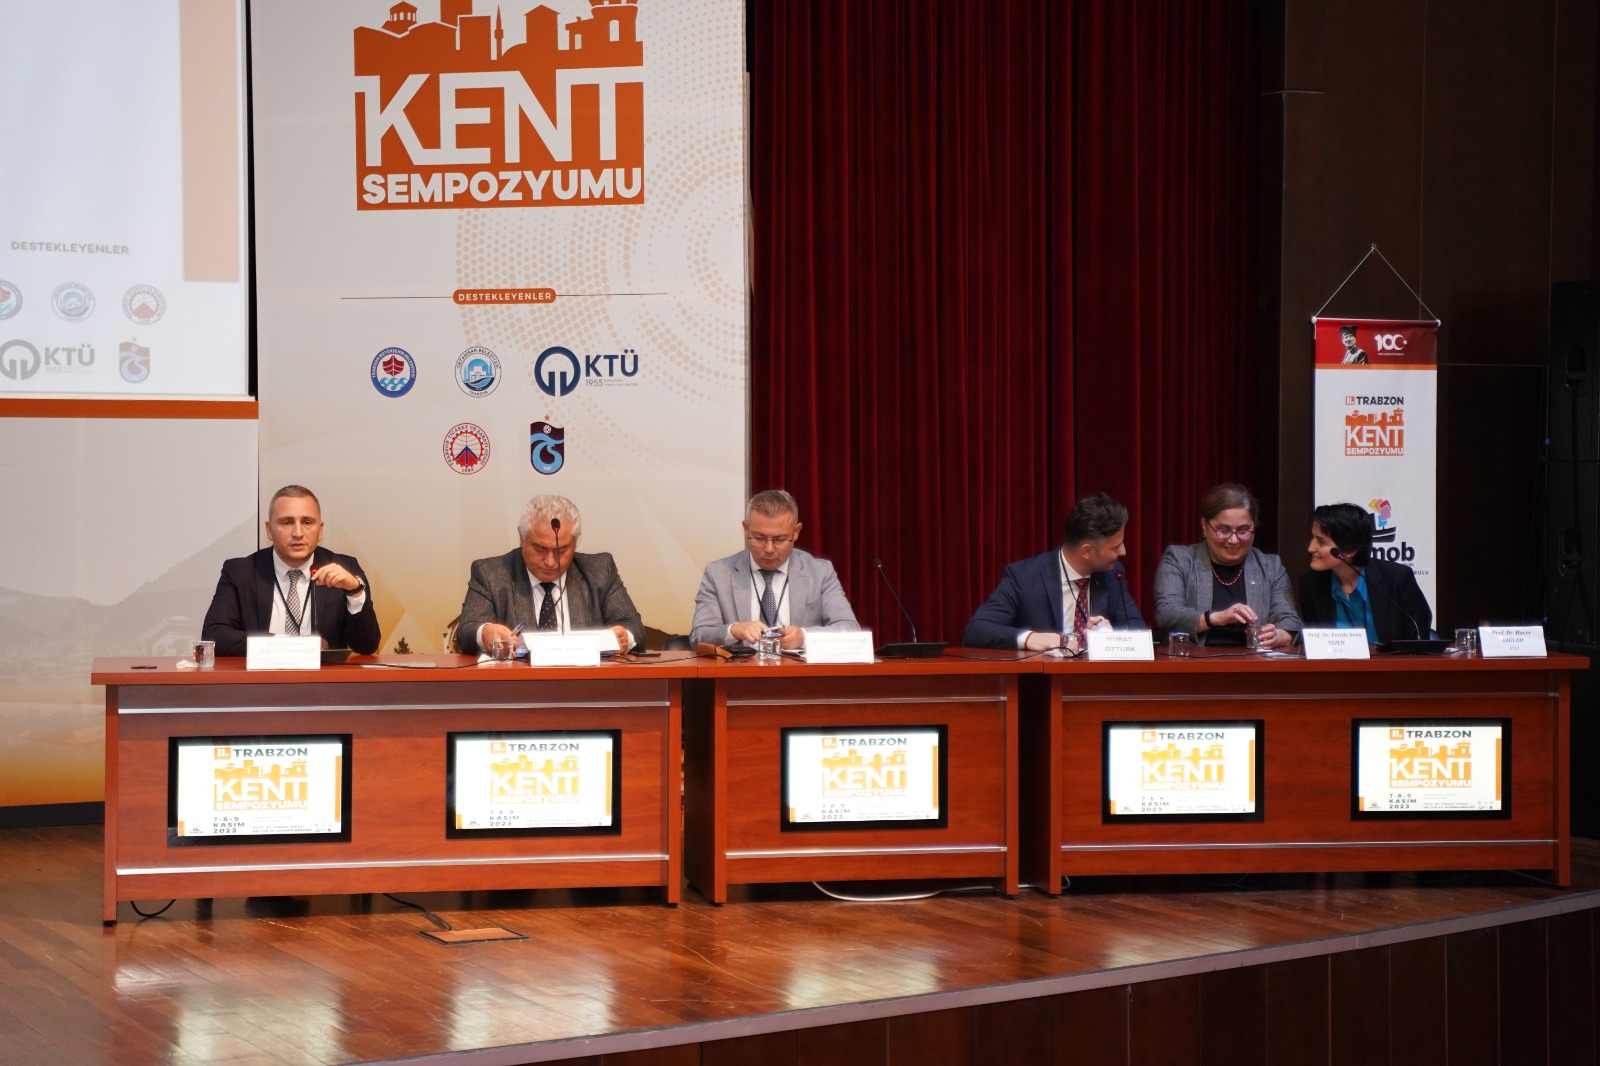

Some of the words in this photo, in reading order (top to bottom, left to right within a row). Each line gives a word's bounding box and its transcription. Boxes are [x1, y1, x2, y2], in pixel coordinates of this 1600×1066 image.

[354, 66, 643, 167] KENT
[362, 167, 642, 205] SEMPOZYUMU
[11, 240, 130, 254] DESTEKLEYENLER
[458, 292, 552, 302] DESTEKLEYENLER
[45, 344, 96, 367] KTÜ
[585, 348, 638, 378] KTÜ
[585, 379, 604, 387] 1955
[1356, 396, 1404, 406] TRABZON
[1345, 425, 1404, 447] KENT
[1346, 447, 1404, 455] SEMPOZYUMU
[1158, 732, 1224, 741] TRABZON
[1406, 730, 1472, 738] TRABZON
[508, 742, 580, 752] TRABZON
[838, 737, 908, 747] TRABZON
[233, 748, 308, 758] TRABZON
[1142, 760, 1224, 782] KENT
[1390, 758, 1472, 779] KENT
[490, 772, 580, 794] KENT
[822, 766, 908, 789] KENT
[214, 778, 308, 801] KENT
[1390, 780, 1472, 788] SEMPOZYUMU
[216, 800, 308, 811] SEMPOZYUMU
